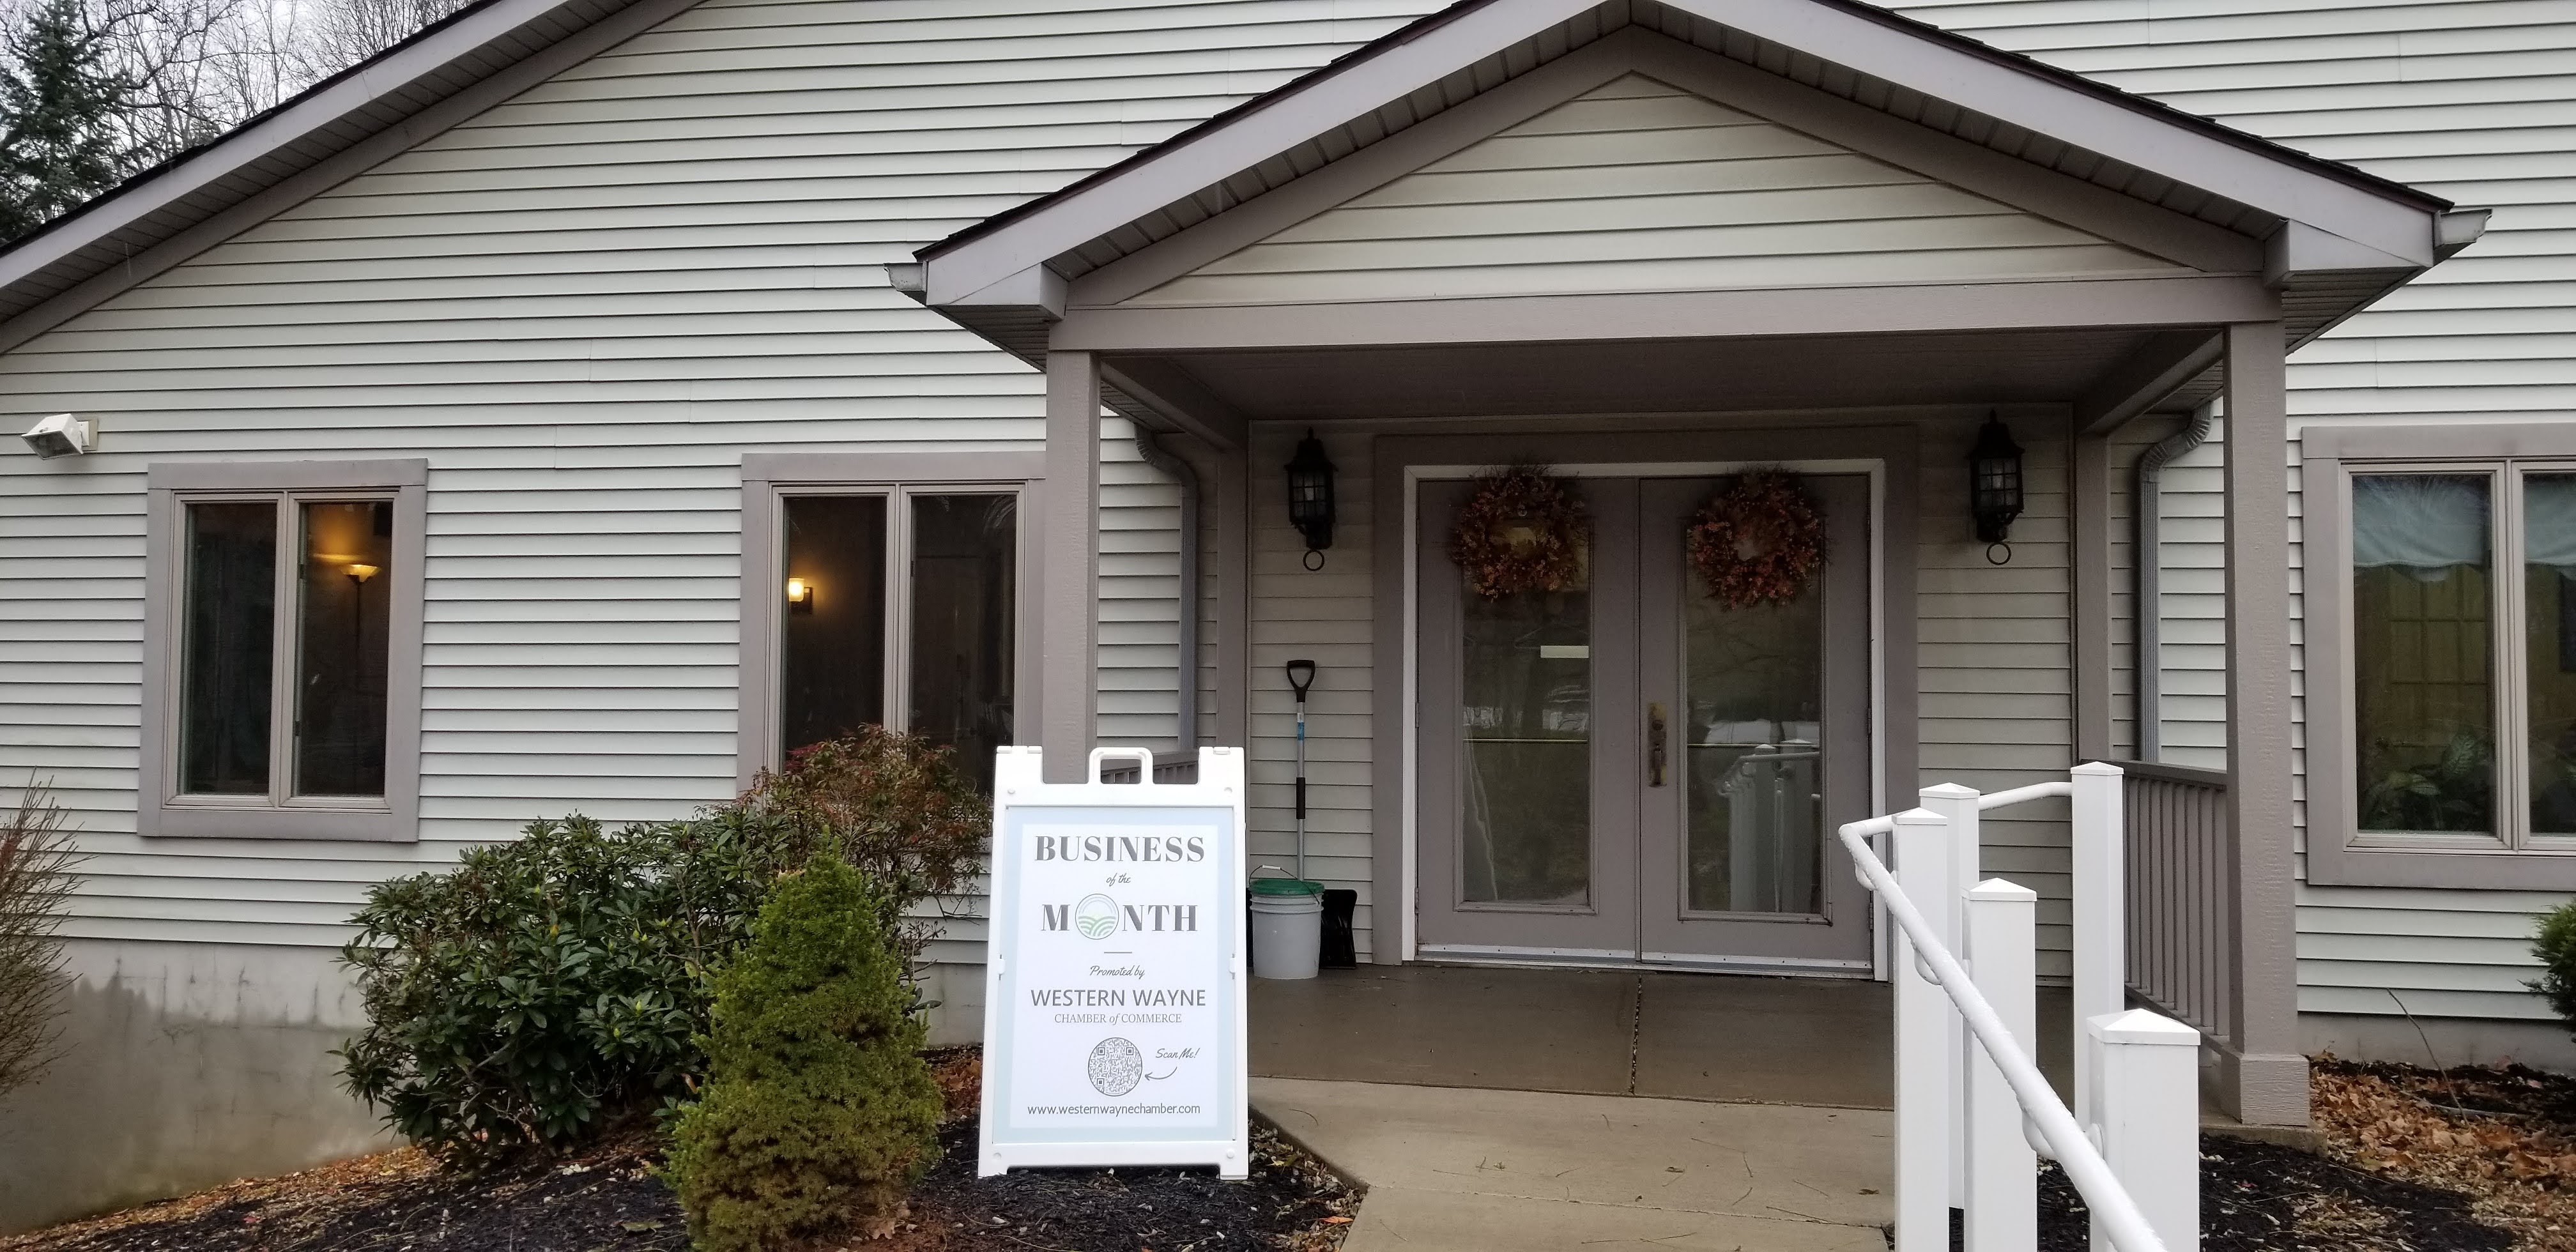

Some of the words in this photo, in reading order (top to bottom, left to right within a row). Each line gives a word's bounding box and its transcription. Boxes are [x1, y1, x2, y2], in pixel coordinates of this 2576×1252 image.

[1034, 836, 1204, 862] BUSINESS
[1106, 873, 1118, 887] of
[1119, 873, 1131, 884] the
[1089, 965, 1135, 976] Promoted
[1134, 965, 1146, 980] by
[1031, 989, 1126, 1007] WESTERN
[1132, 989, 1206, 1007] WAYNE
[1054, 1014, 1107, 1024] CHAMBER
[1108, 1013, 1121, 1026] of
[1121, 1013, 1182, 1023] COMMERCE
[1155, 1048, 1179, 1059] Scan
[1178, 1048, 1200, 1060] Me!
[1027, 1103, 1200, 1117] www.westernwaynechamber.com
